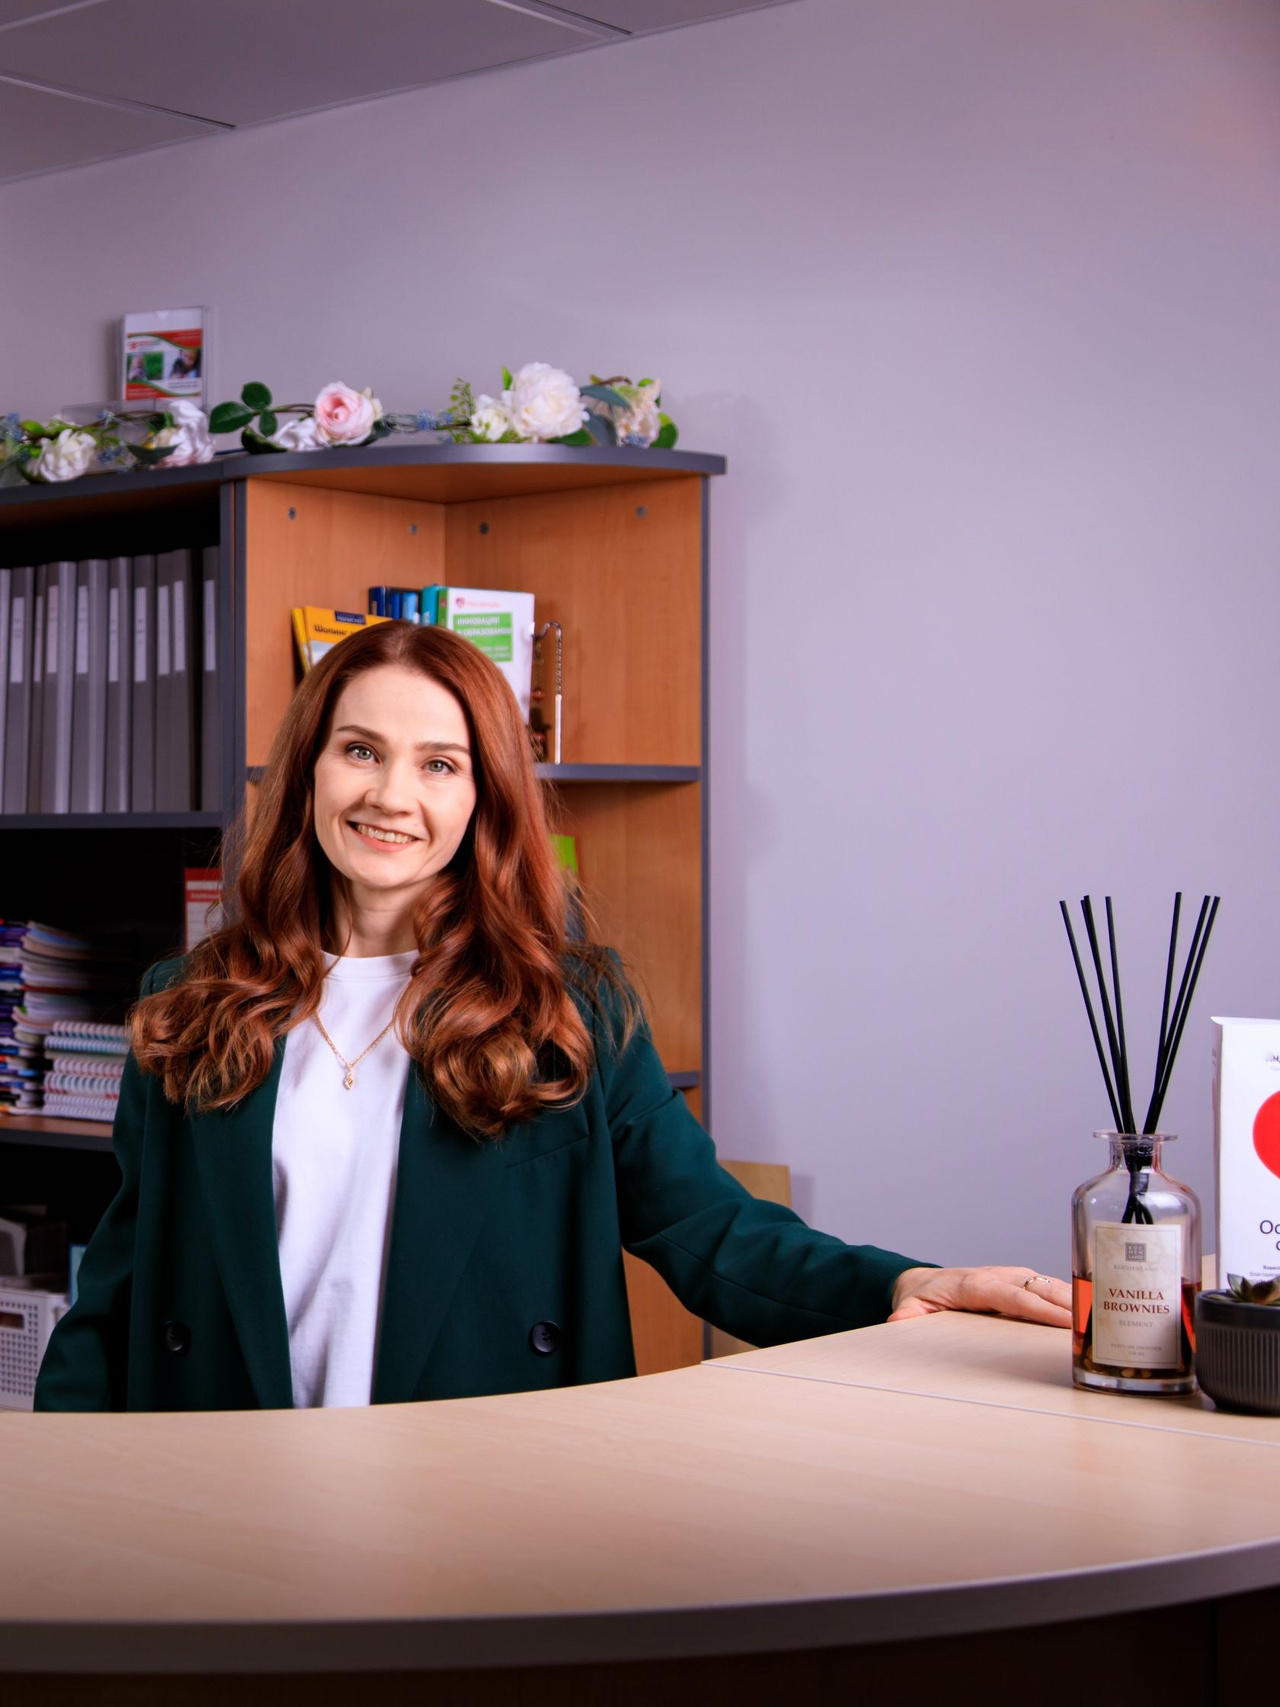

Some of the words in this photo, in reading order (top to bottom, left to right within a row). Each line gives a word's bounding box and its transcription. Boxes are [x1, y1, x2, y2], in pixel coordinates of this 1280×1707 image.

[1108, 1288, 1164, 1301] VANILLA
[1103, 1301, 1170, 1315] BROWNIES
[1118, 1320, 1154, 1329] ELEMENT
